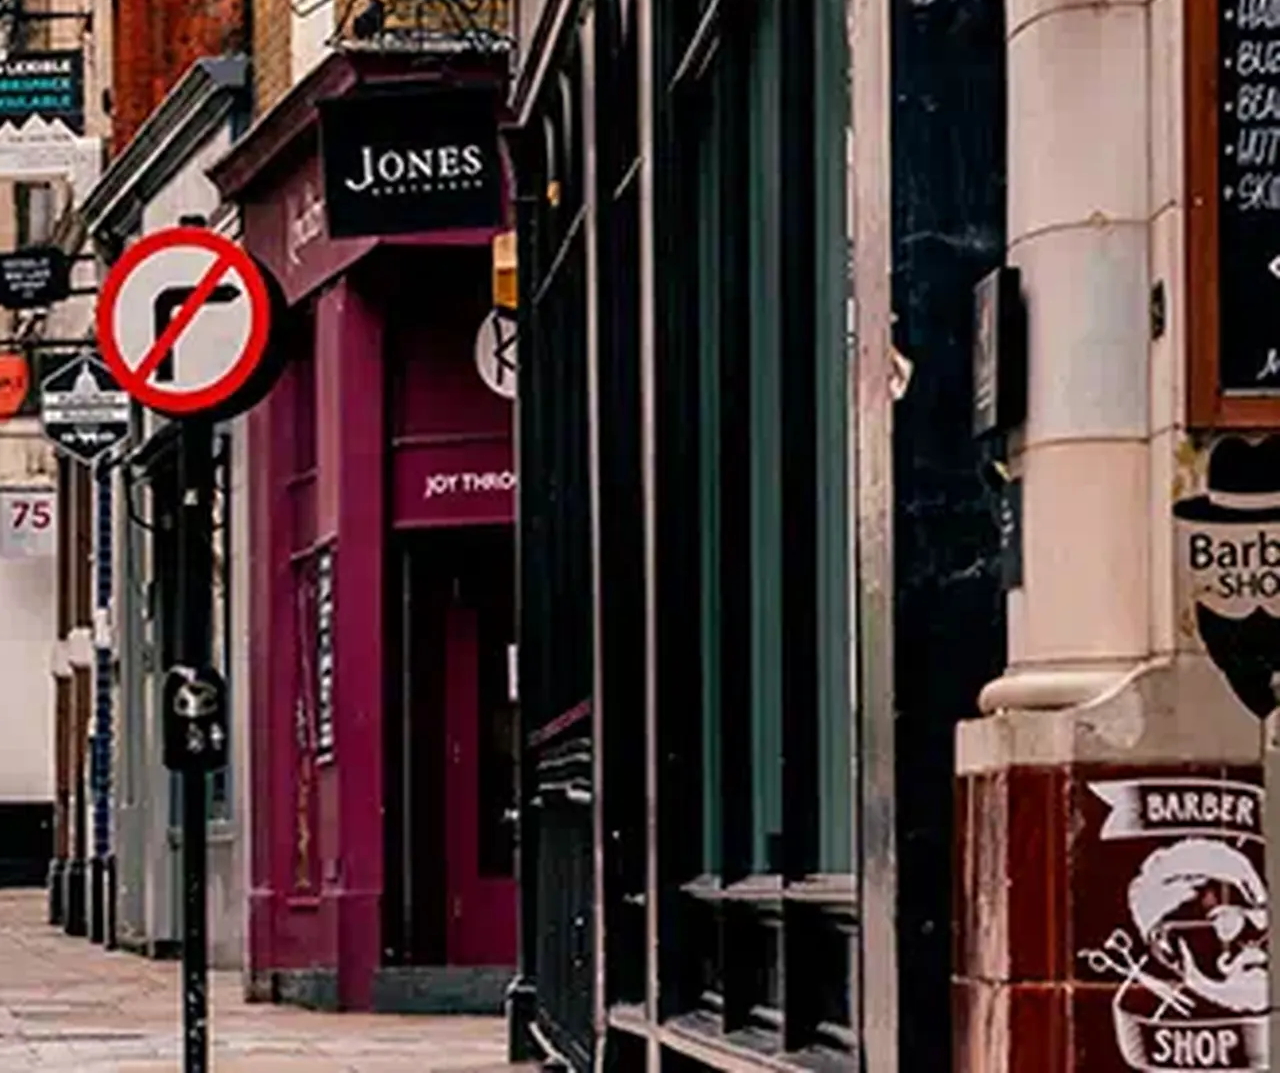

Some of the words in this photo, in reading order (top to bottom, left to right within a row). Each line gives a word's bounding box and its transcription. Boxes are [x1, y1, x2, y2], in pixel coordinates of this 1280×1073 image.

[423, 474, 459, 500] JOY
[12, 501, 52, 529] 75
[1146, 791, 1254, 827] BARBER
[1153, 1029, 1239, 1068] SHOP
